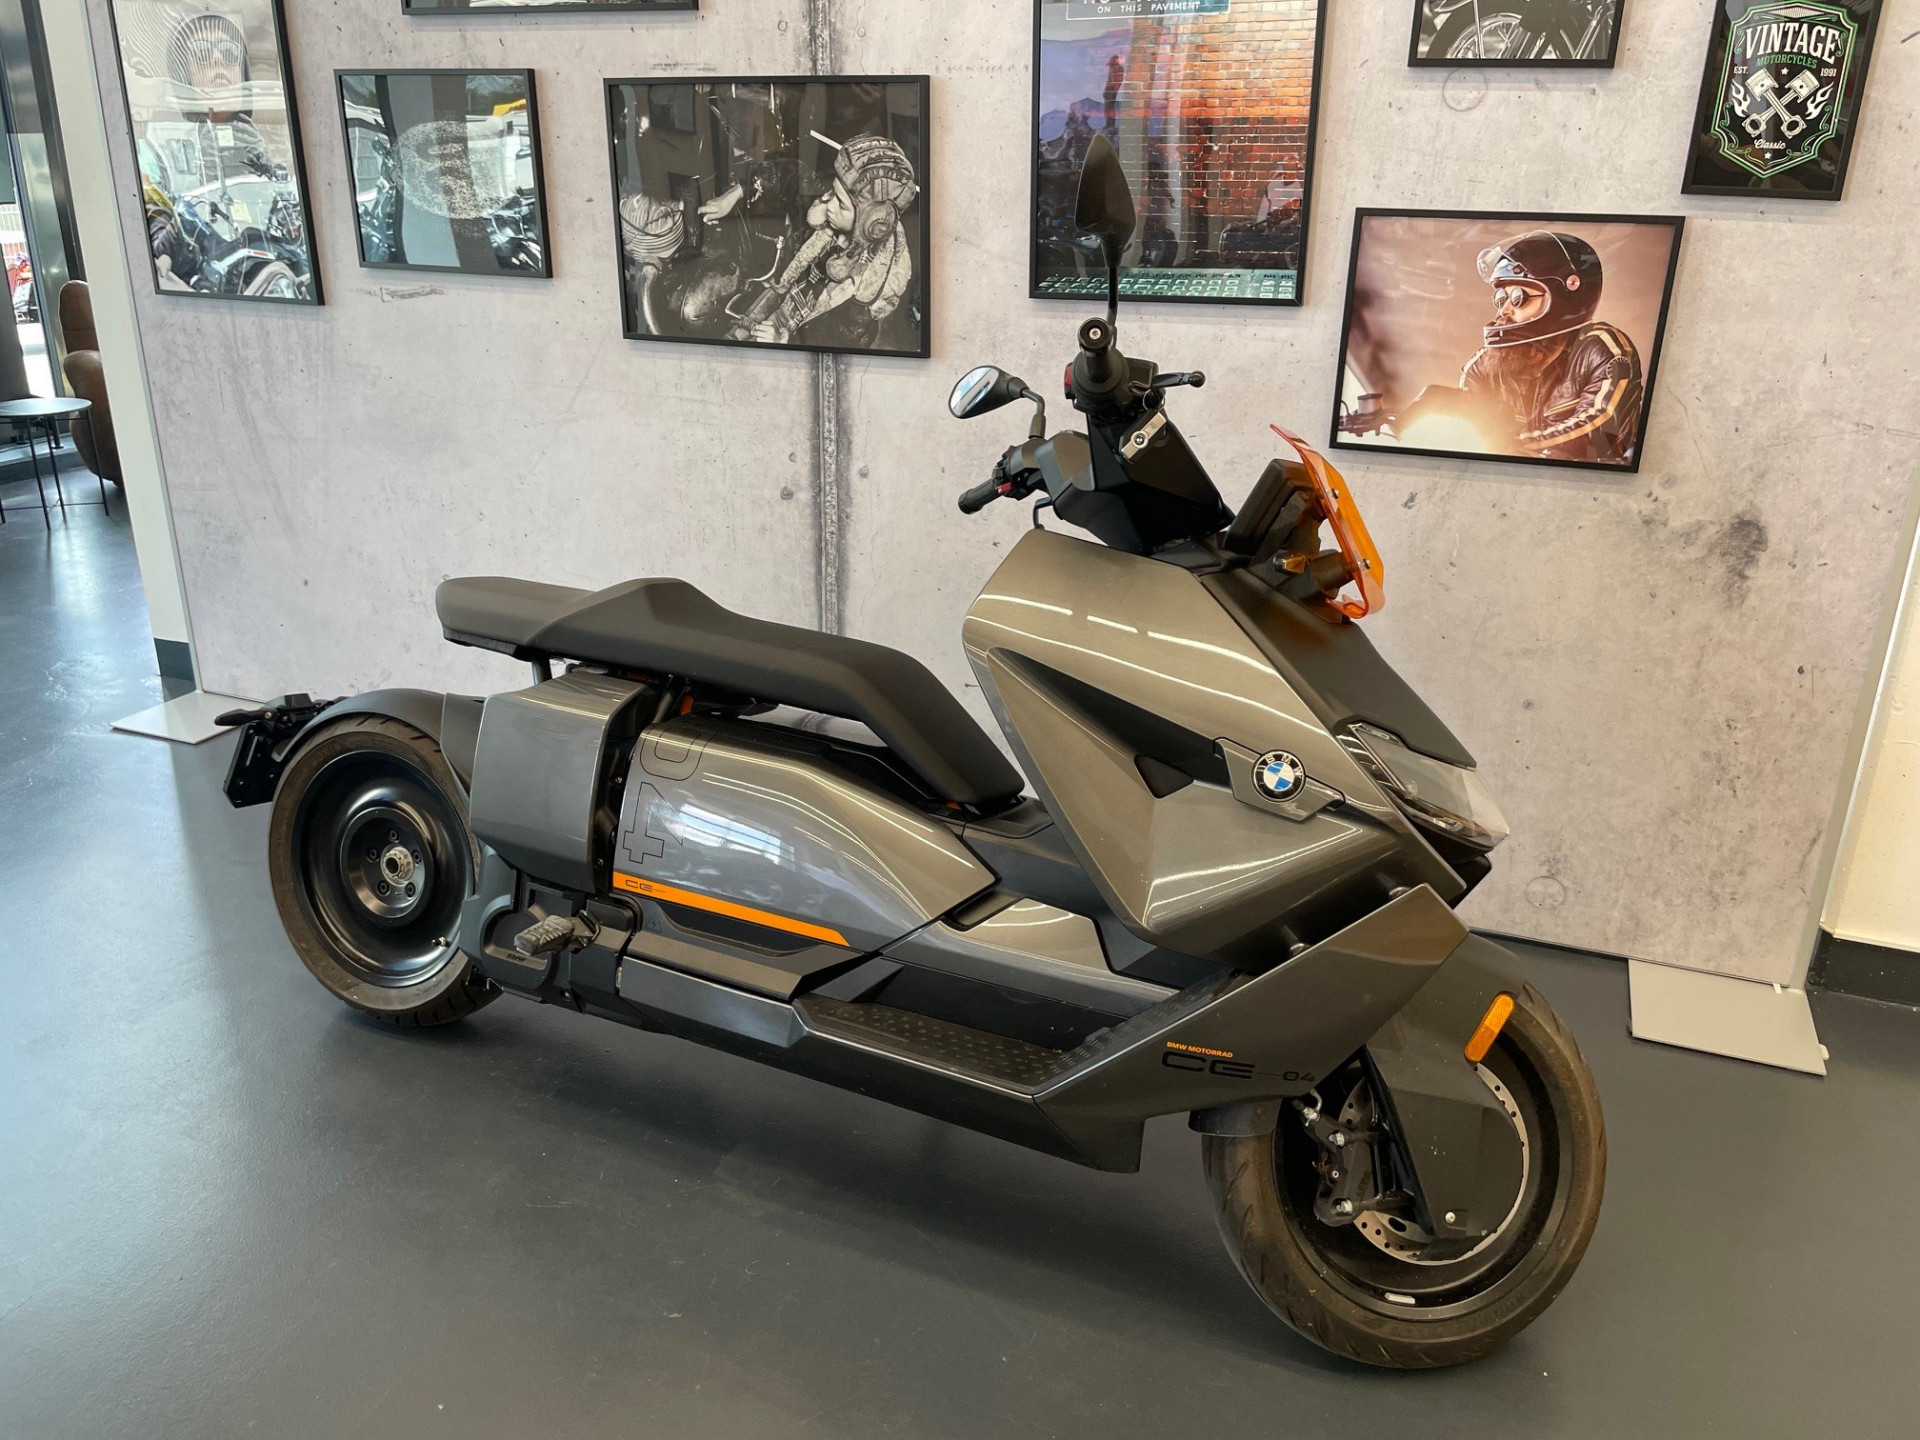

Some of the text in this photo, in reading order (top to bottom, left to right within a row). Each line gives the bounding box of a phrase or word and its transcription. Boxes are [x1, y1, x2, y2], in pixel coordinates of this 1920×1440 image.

[1097, 6, 1111, 14] ON
[1151, 1, 1200, 11] PAVEMENT
[1746, 22, 1841, 64] VINTAGE
[1756, 54, 1818, 69] MOTORCYCLES
[1733, 66, 1837, 77] EST. 1991
[1754, 138, 1786, 150] Classic
[1265, 753, 1304, 780] BMW
[1166, 1041, 1234, 1058] BMW MOTORRAD
[1161, 1051, 1316, 1082] CE 04
